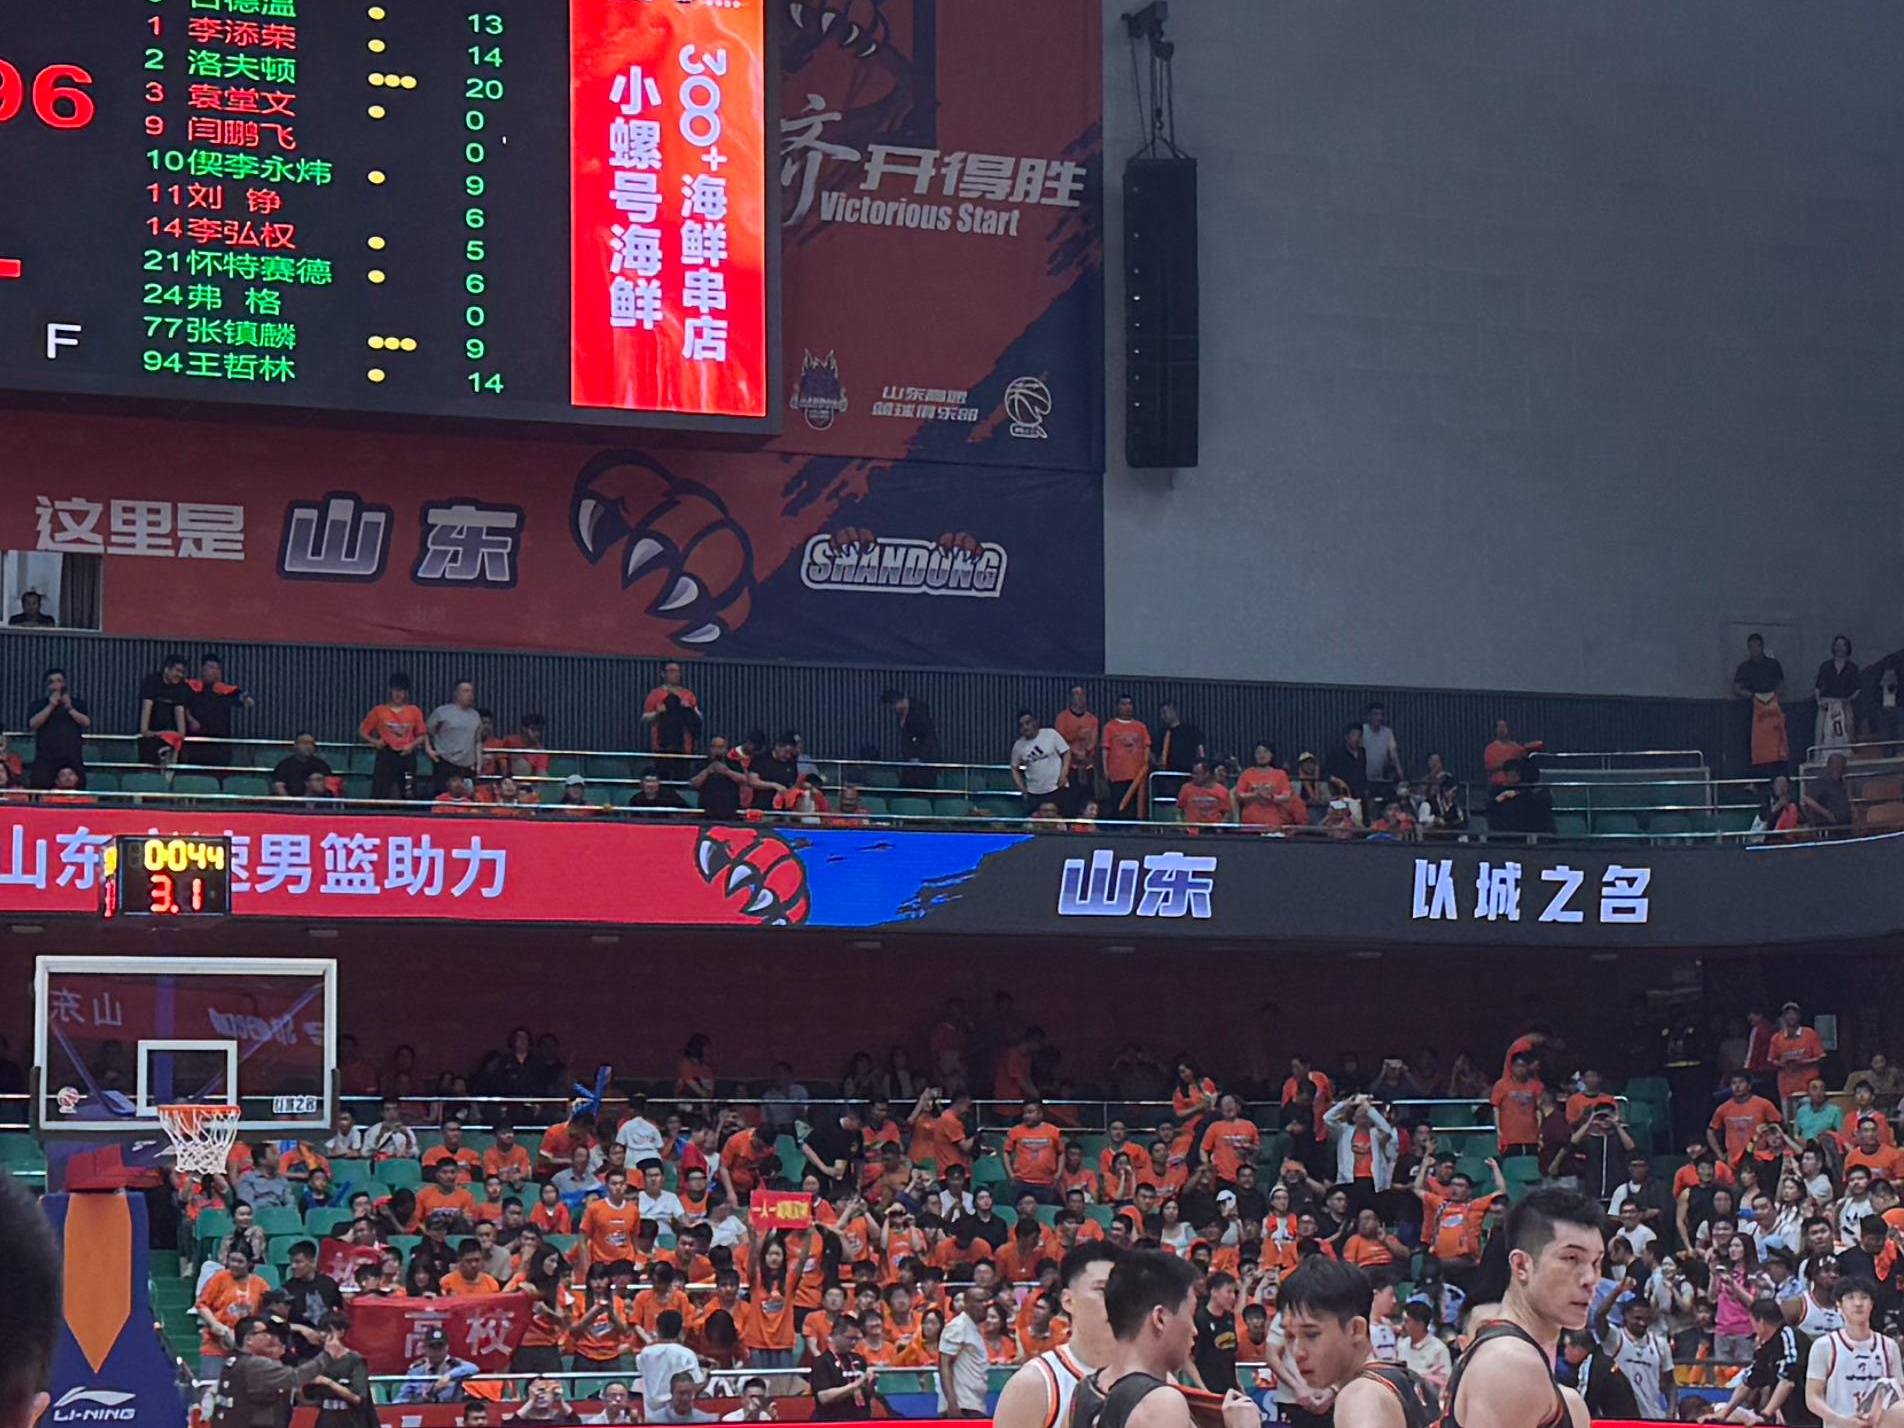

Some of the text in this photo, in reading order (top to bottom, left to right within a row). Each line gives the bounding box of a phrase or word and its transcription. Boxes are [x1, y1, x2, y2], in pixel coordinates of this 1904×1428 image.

[148, 16, 161, 35] 1
[467, 45, 504, 68] 14
[467, 12, 504, 35] 13
[144, 49, 504, 100] 2 洛夫顿 20
[145, 82, 165, 102] 3
[465, 110, 484, 131] 0
[144, 115, 484, 163] 9 闫鹏飞 0
[147, 149, 184, 171] 10
[465, 176, 484, 196] 9
[146, 183, 179, 205] 11
[465, 208, 484, 229] 6
[607, 64, 665, 334] 小螺号海鲜
[820, 188, 1022, 238] Victorious Start
[146, 217, 484, 261] 14 李弘权 5
[143, 250, 484, 294] 21 怀特赛德 6
[143, 284, 183, 306] 24
[466, 306, 484, 327] 0
[47, 322, 82, 361] F
[143, 316, 484, 360] 77 张镇麟 9
[143, 351, 504, 395] 94 王哲林 14
[34, 494, 524, 582] 这里是 山东
[1057, 848, 1217, 920] 山东
[1410, 858, 1650, 925] 以城之名
[51, 1404, 135, 1424] LI-NING
